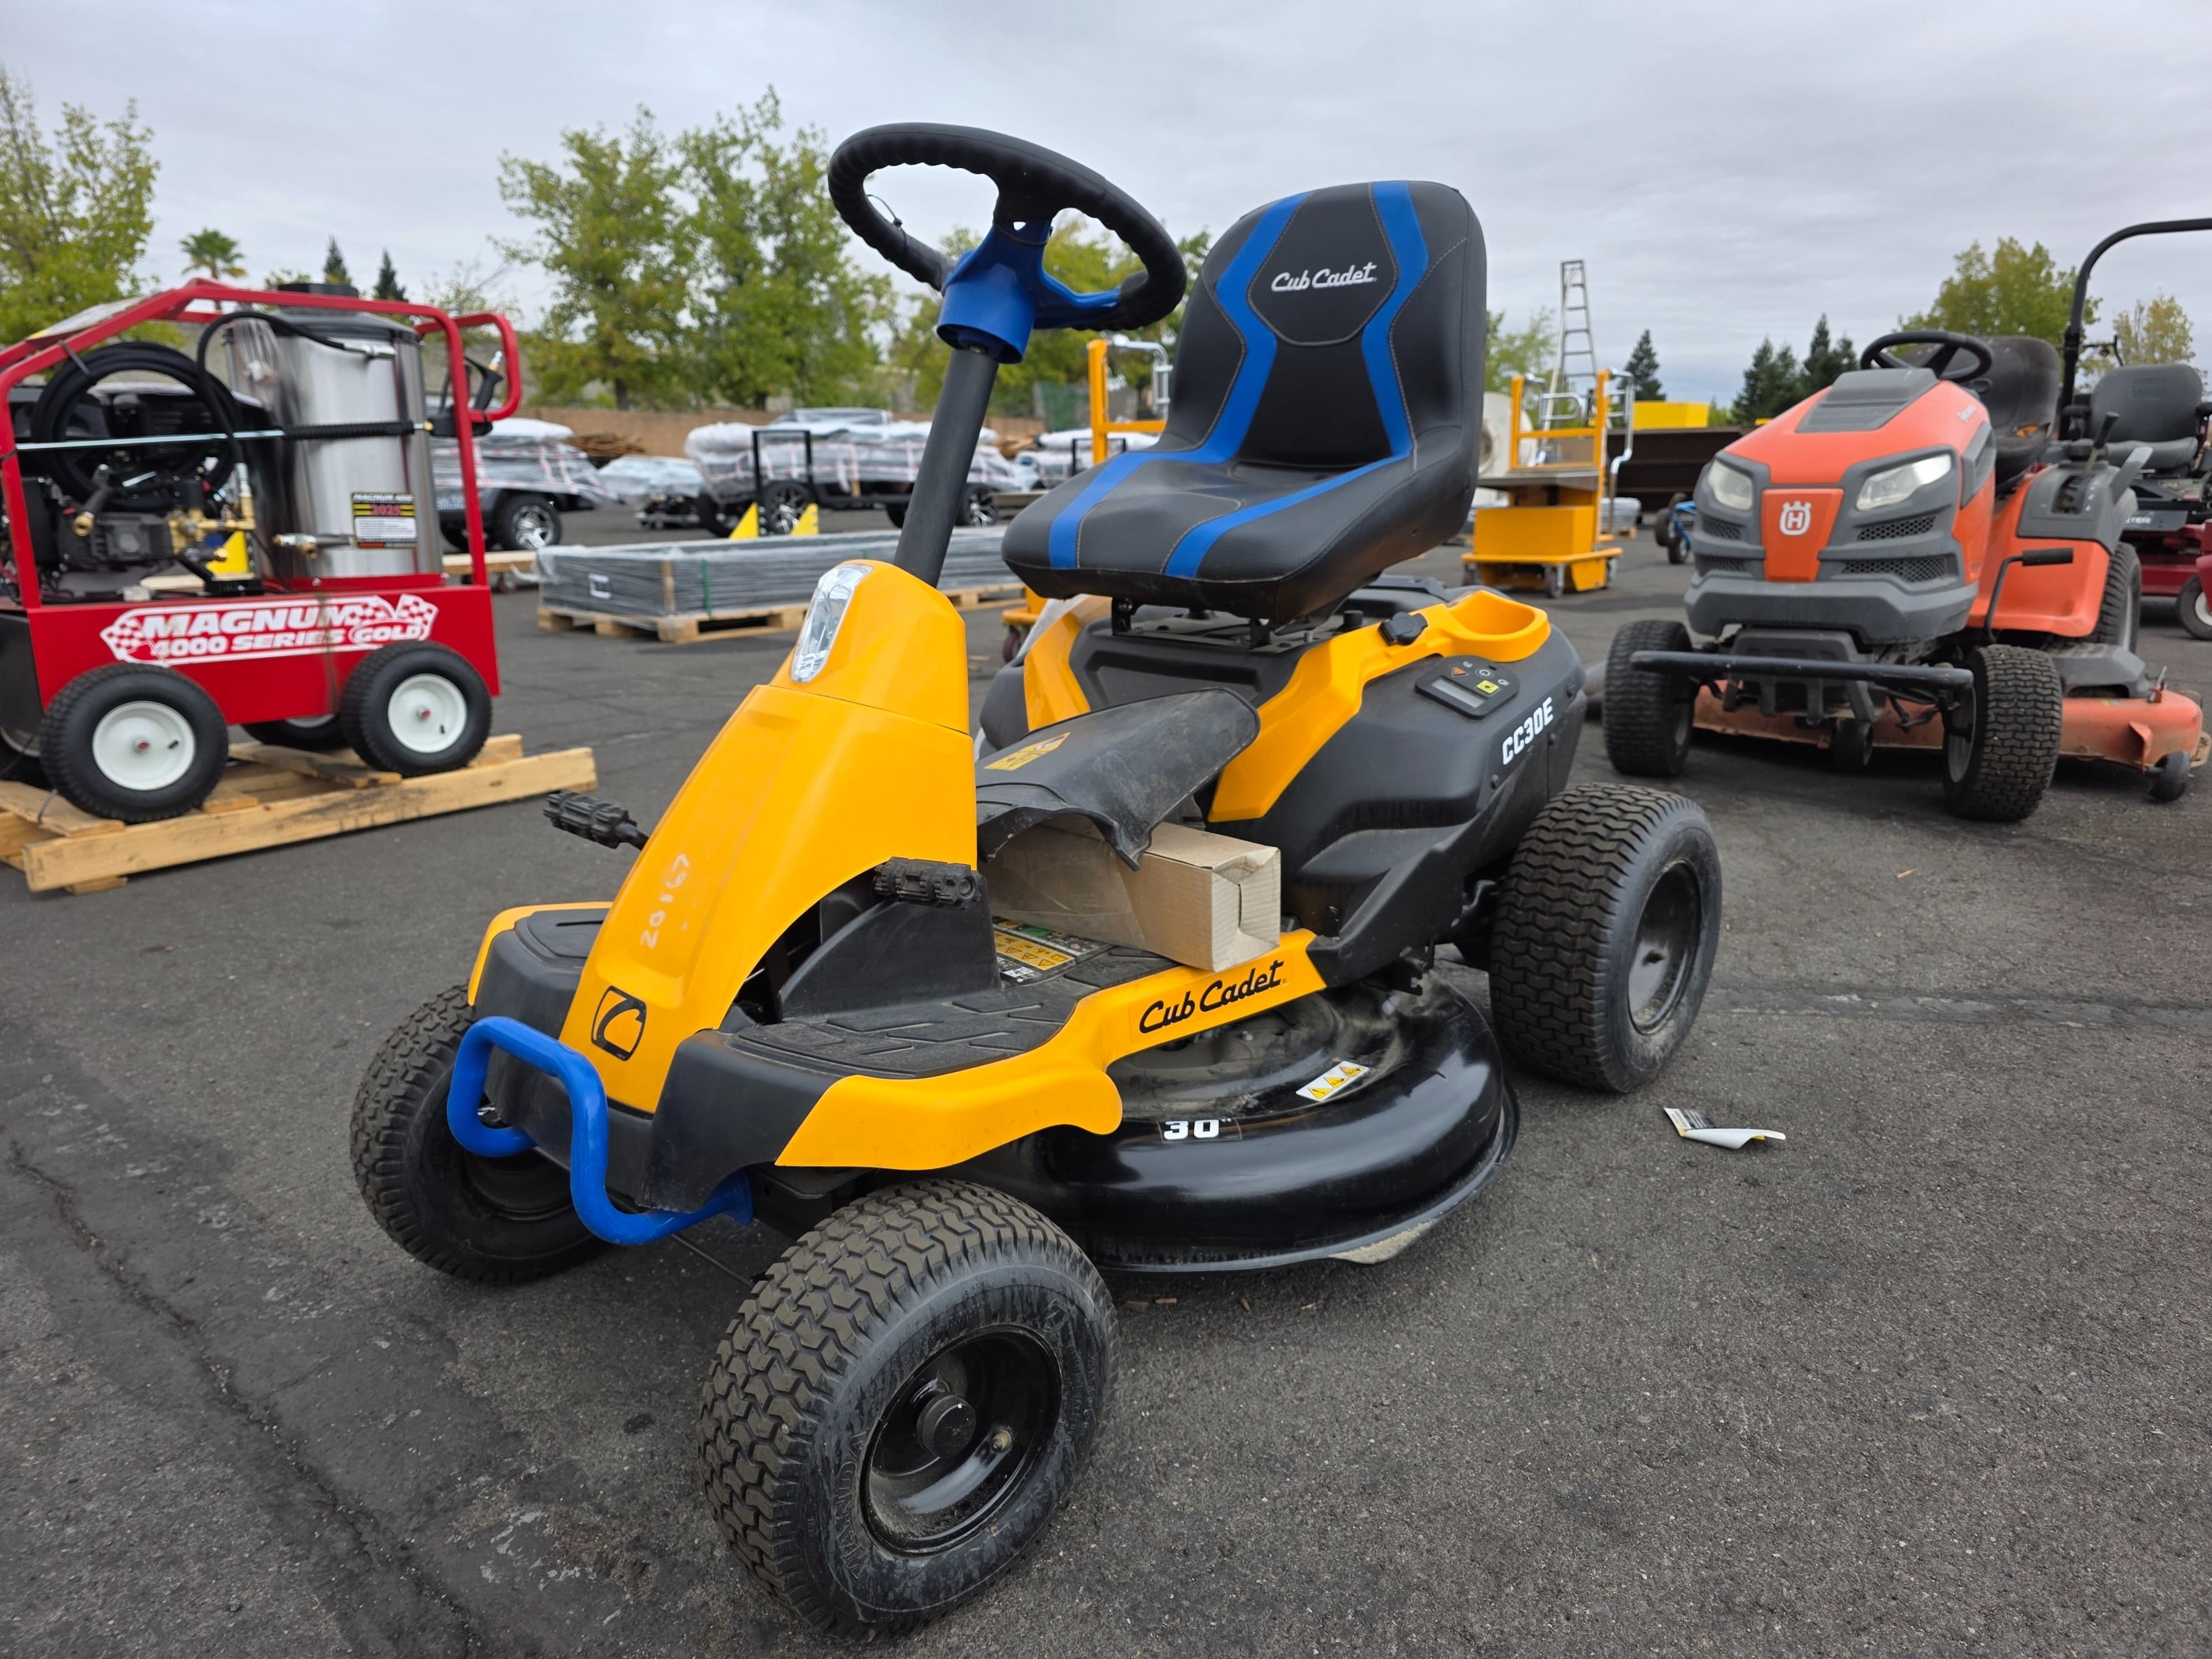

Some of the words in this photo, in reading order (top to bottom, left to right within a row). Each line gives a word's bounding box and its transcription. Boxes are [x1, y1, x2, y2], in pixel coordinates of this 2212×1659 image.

[1271, 270, 1311, 292] Cub
[1311, 262, 1378, 289] Cadet
[142, 606, 354, 639] MAGNUM
[152, 636, 228, 657] 4000
[230, 628, 345, 651] SERIES
[357, 624, 420, 643] GOLD
[1502, 696, 1554, 765] CC30E
[1139, 990, 1196, 1034] Cub
[1199, 959, 1284, 1012] Cadet
